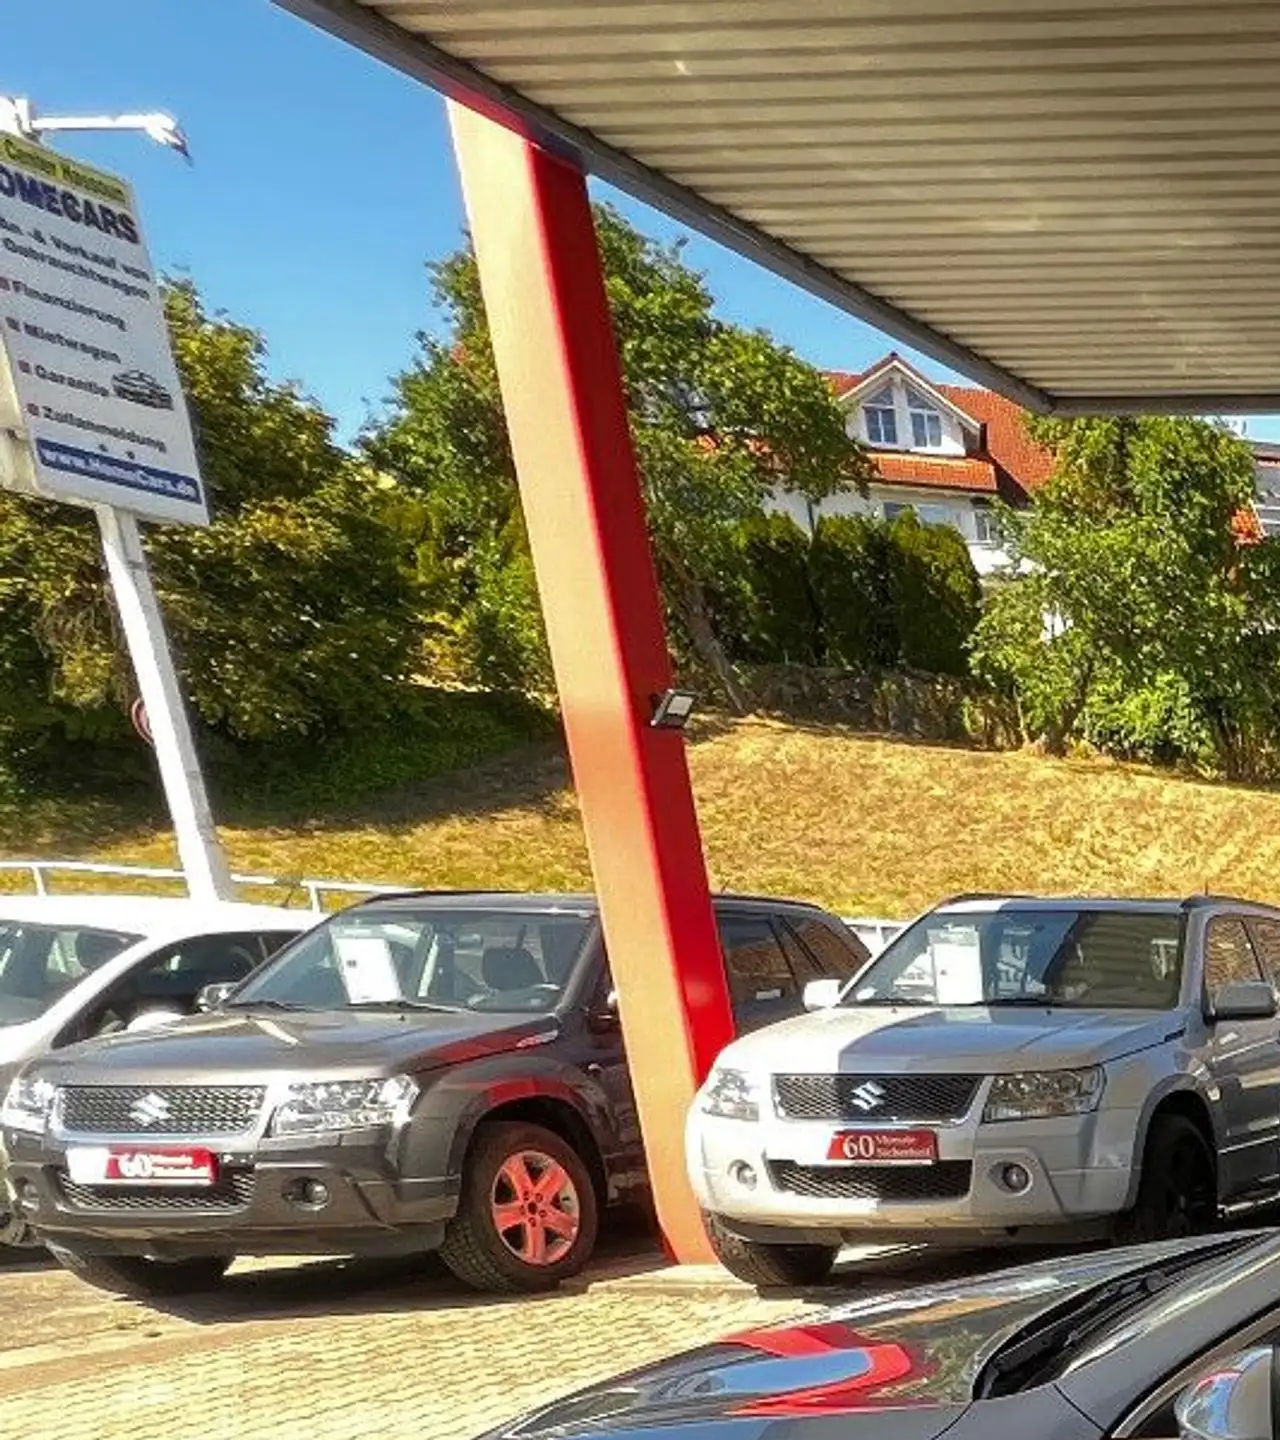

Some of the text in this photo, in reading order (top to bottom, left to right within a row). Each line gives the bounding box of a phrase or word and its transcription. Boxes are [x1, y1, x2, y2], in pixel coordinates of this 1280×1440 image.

[12, 280, 128, 332] Finanzierung
[23, 322, 121, 364] Mietwagen
[35, 364, 109, 397] Garantie
[842, 1135, 875, 1158] 60
